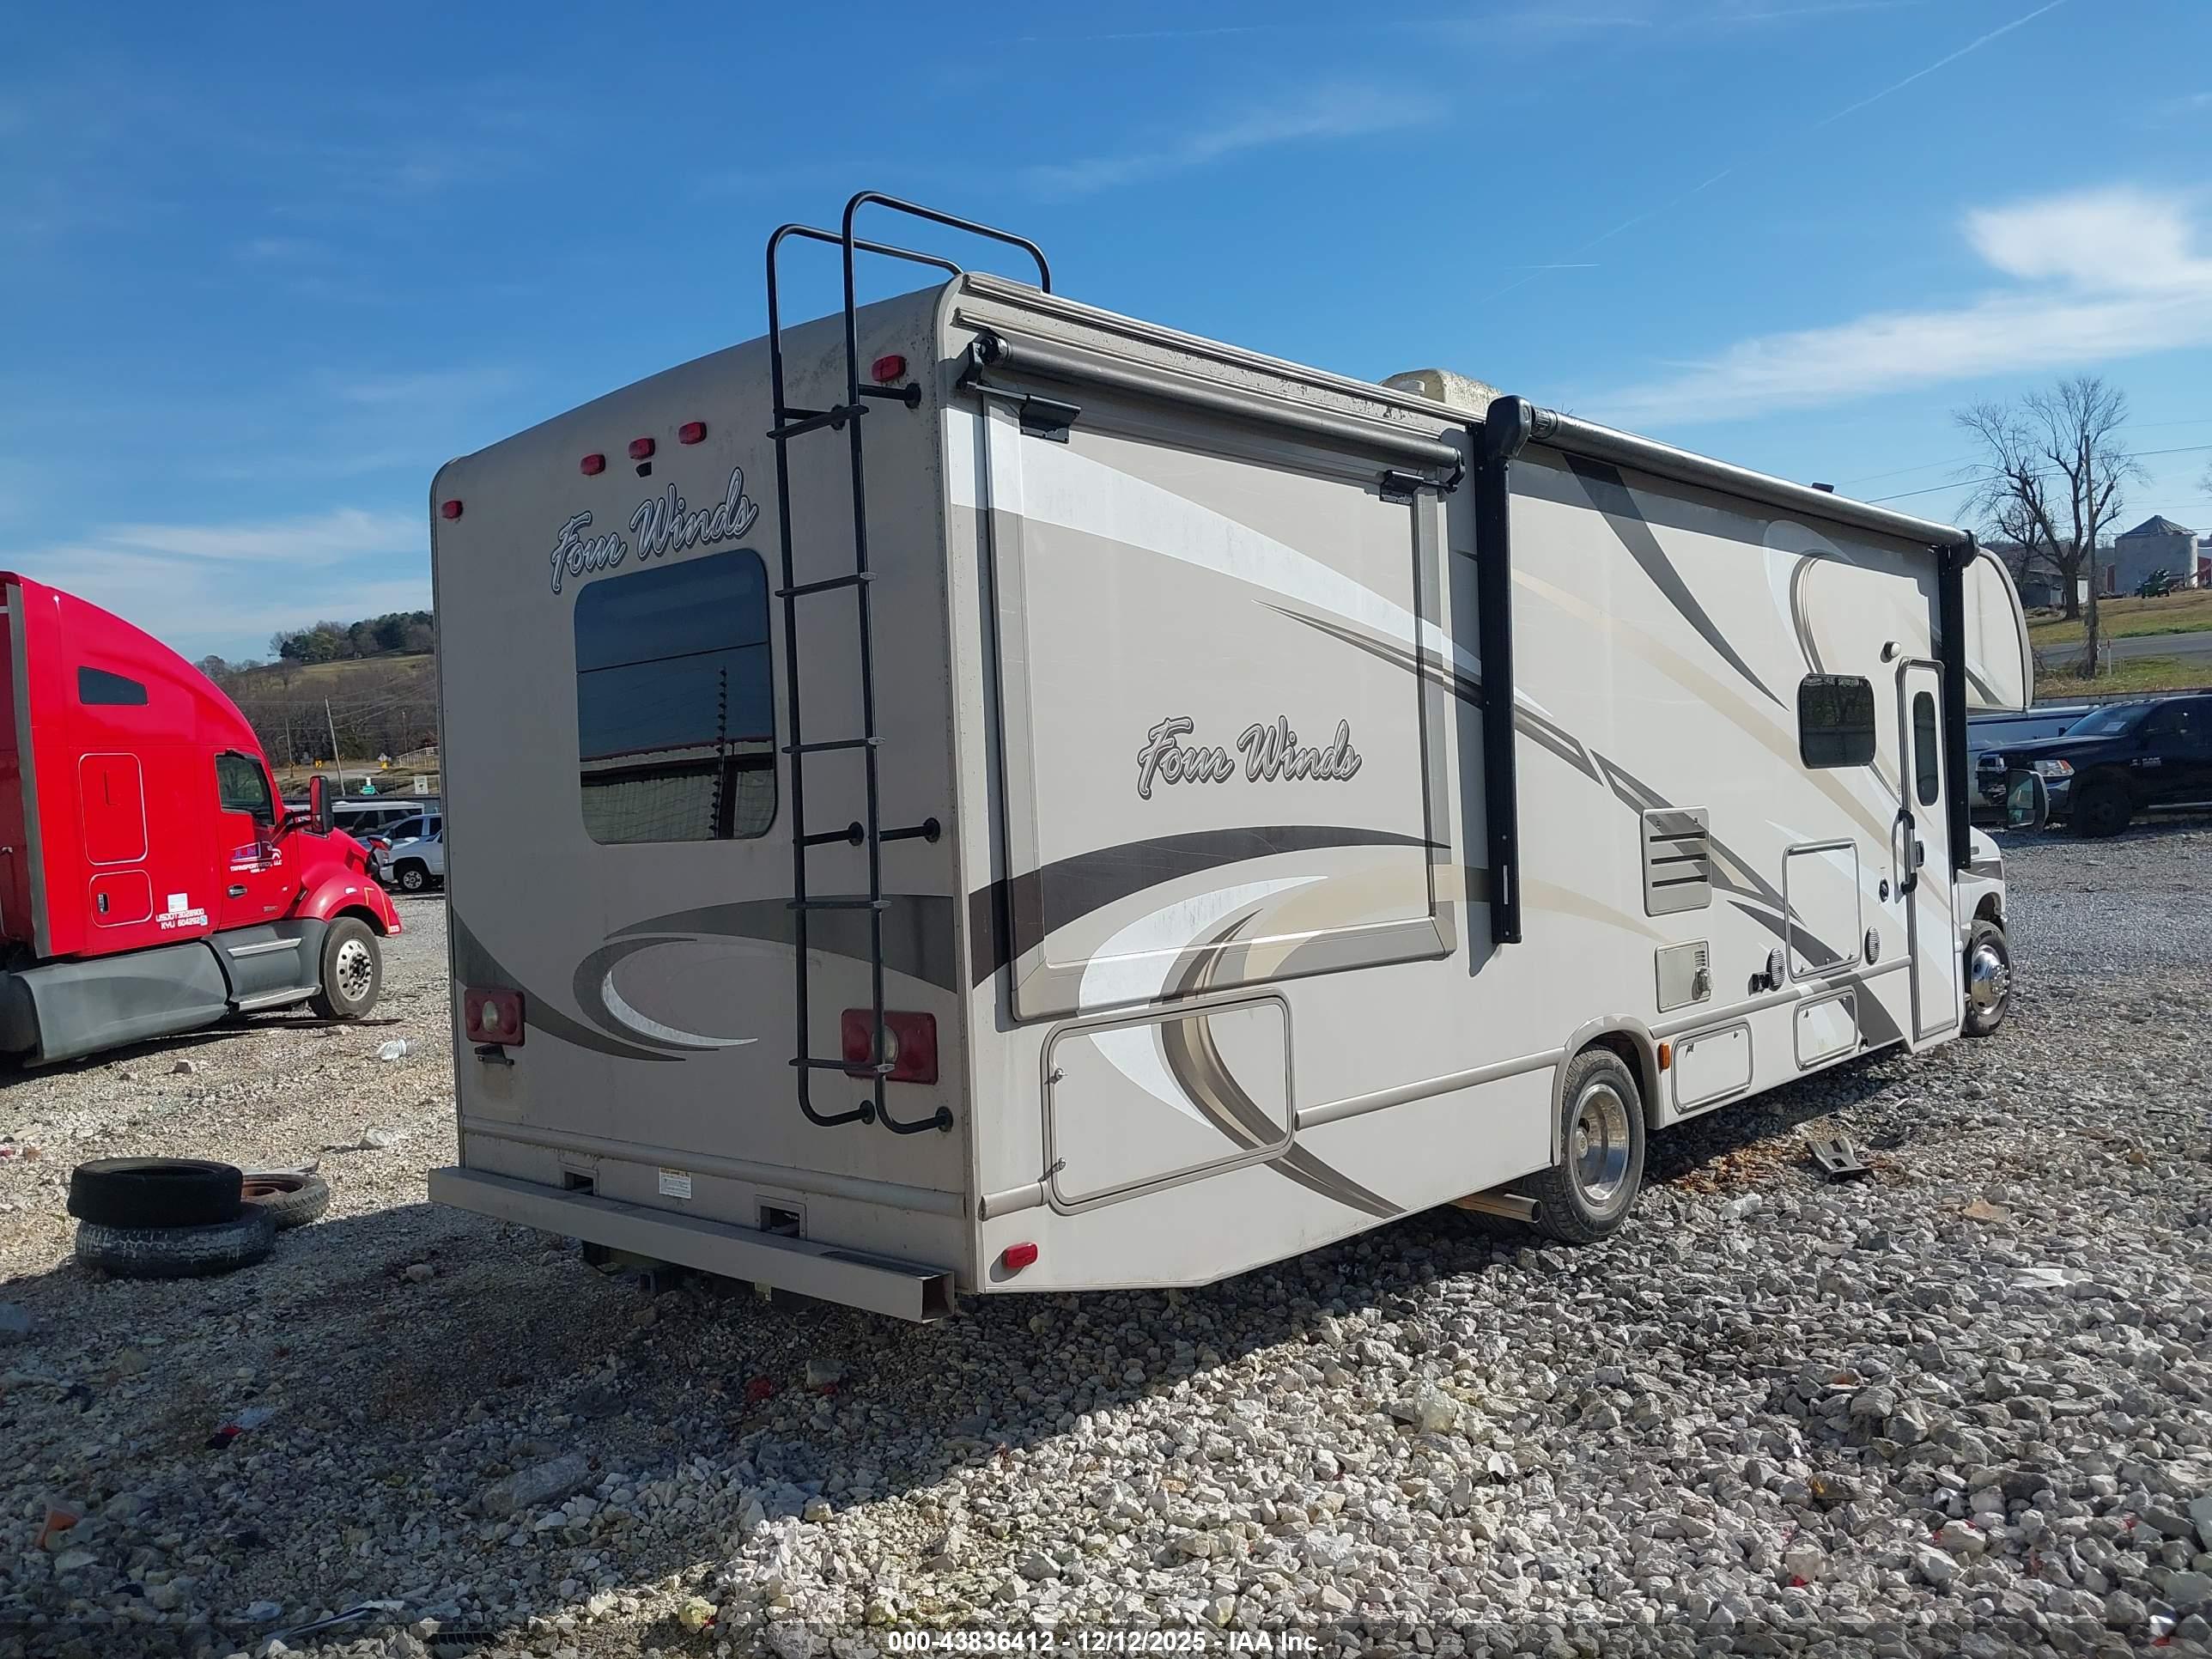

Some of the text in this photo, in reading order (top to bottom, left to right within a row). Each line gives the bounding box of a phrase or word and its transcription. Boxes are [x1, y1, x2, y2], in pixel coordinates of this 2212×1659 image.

[550, 467, 759, 595] Four Winds
[1137, 714, 1362, 800] Four Winds
